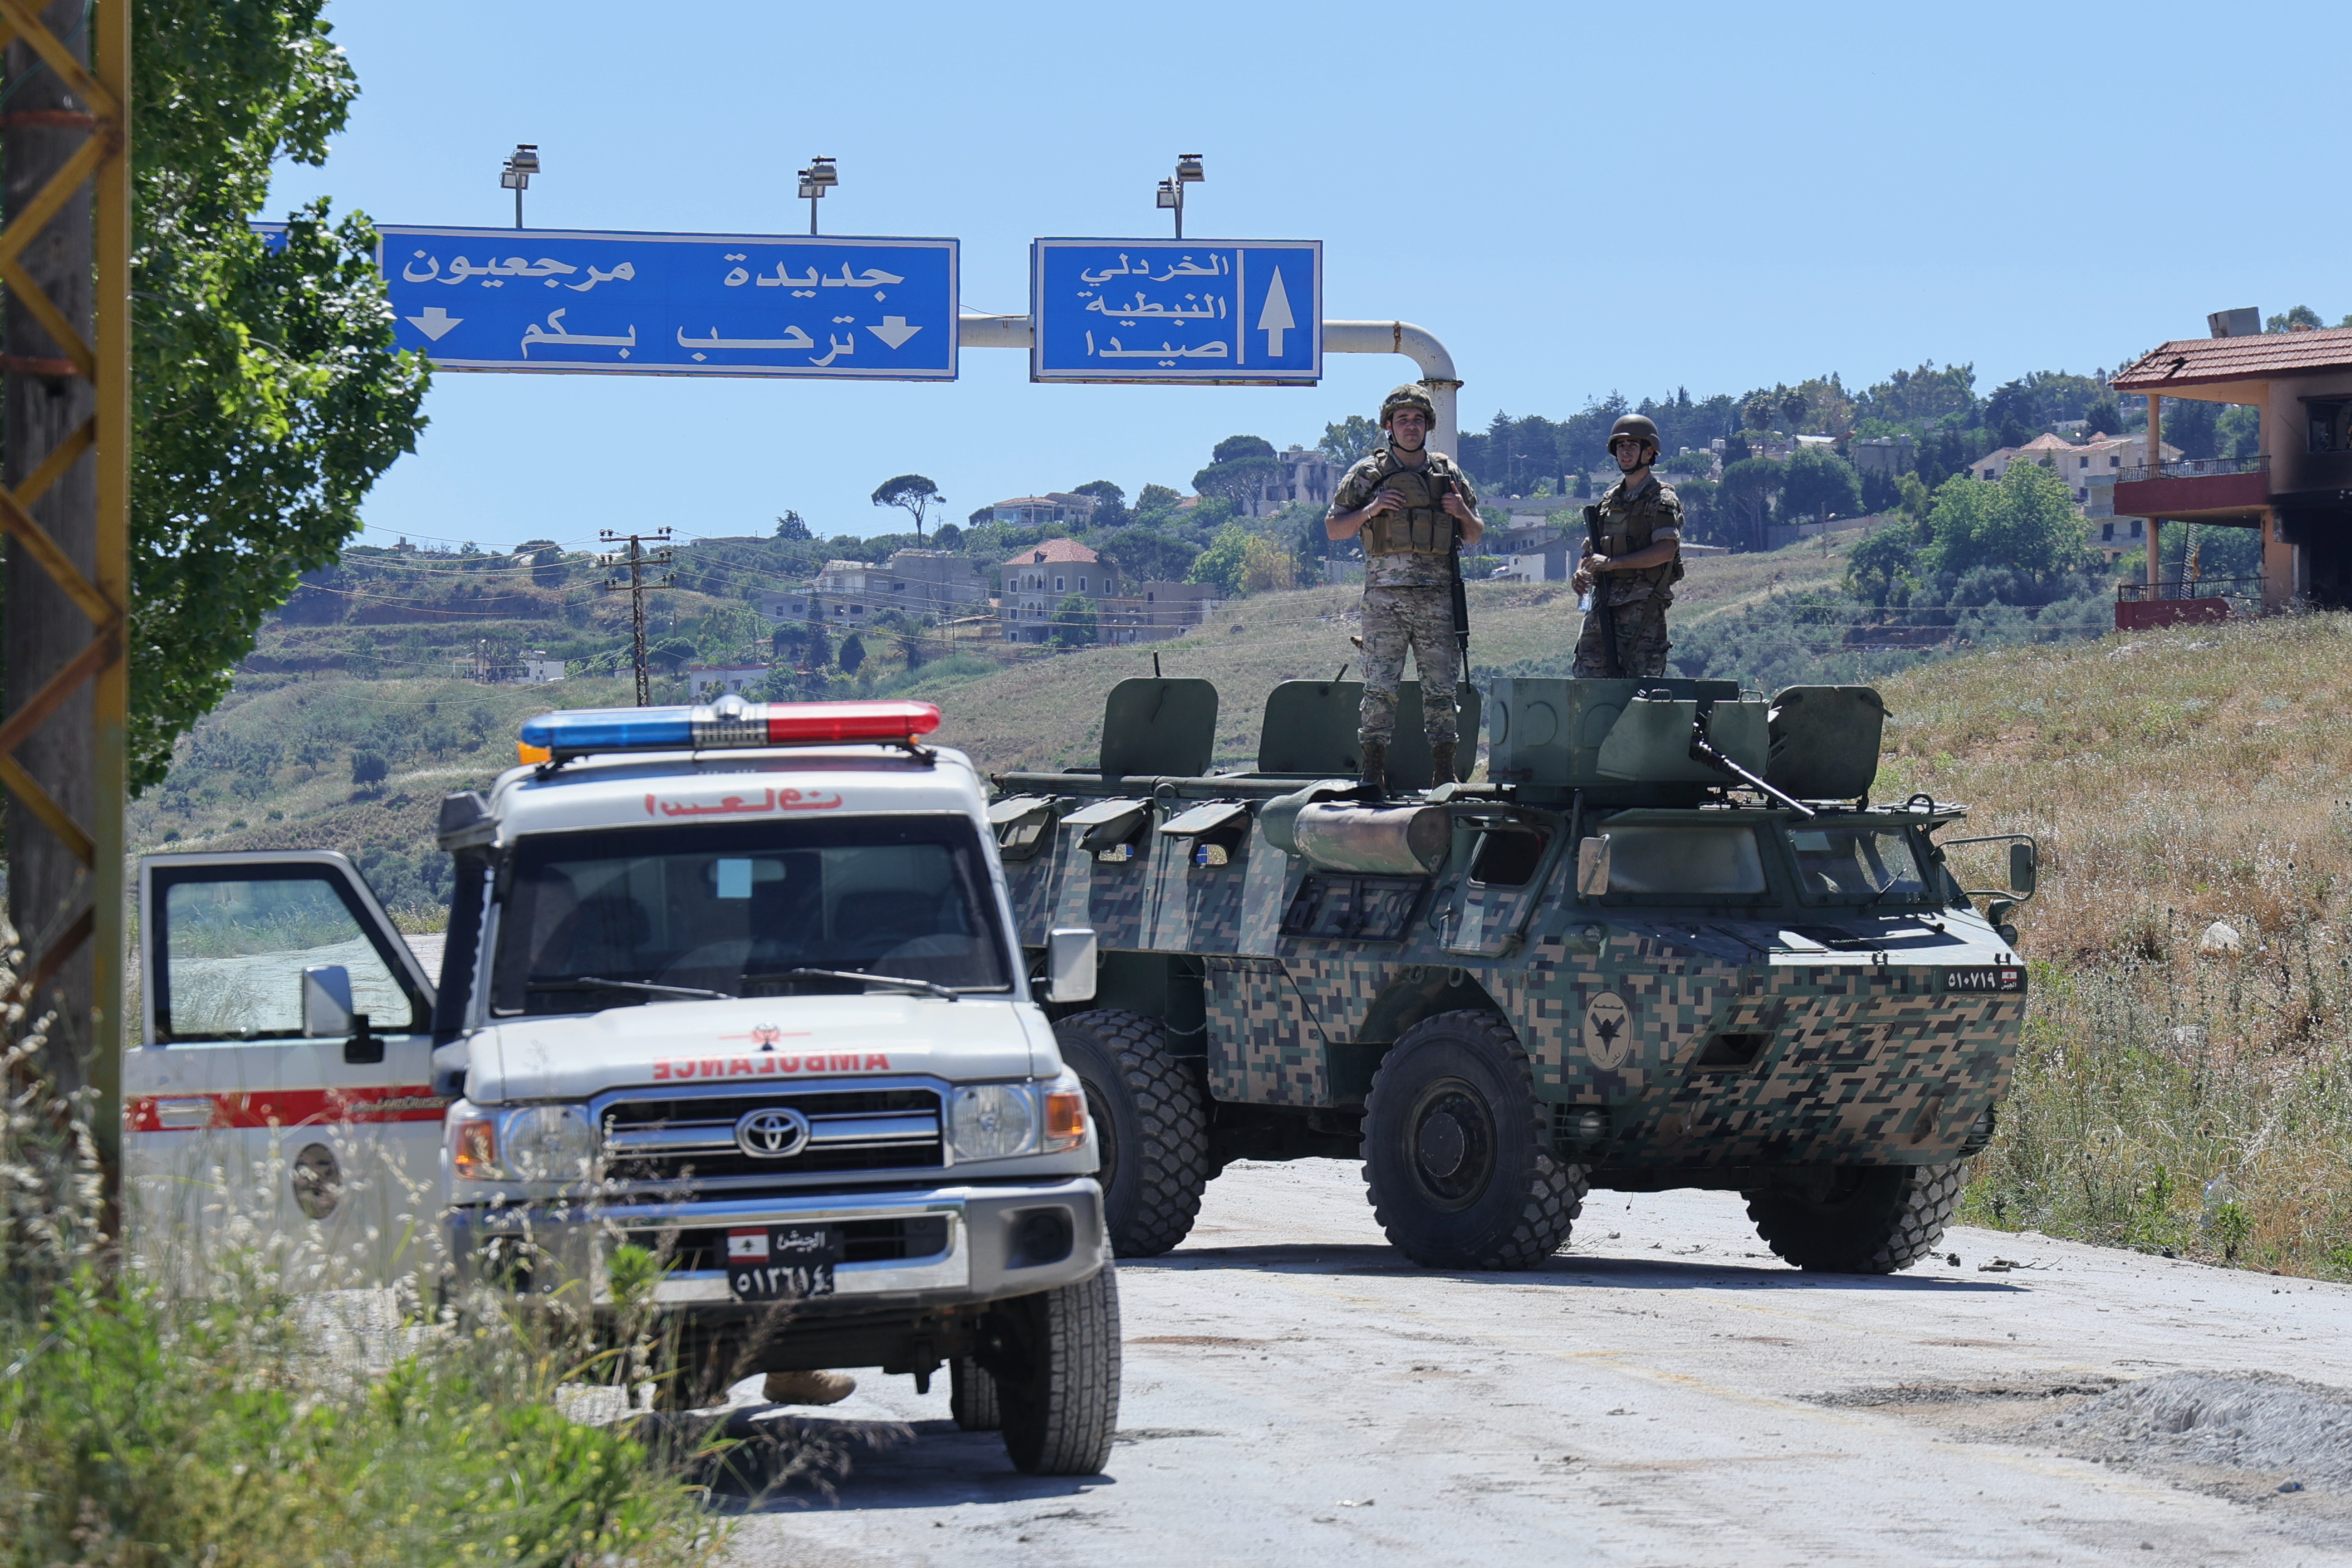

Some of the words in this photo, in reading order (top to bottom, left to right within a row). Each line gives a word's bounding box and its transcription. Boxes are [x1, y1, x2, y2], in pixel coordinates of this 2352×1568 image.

[403, 249, 635, 292] مرجعيون
[724, 253, 905, 302] جديدة
[1080, 253, 1229, 287] الخردلي
[1076, 290, 1228, 327] النبطية
[521, 308, 636, 359] بكم
[677, 315, 855, 367] ترحب
[1085, 329, 1229, 367] صيدا
[1948, 972, 1996, 988] ٥١٠٧١٩
[2000, 980, 2017, 990] الجيش
[776, 1229, 825, 1253] الجيش
